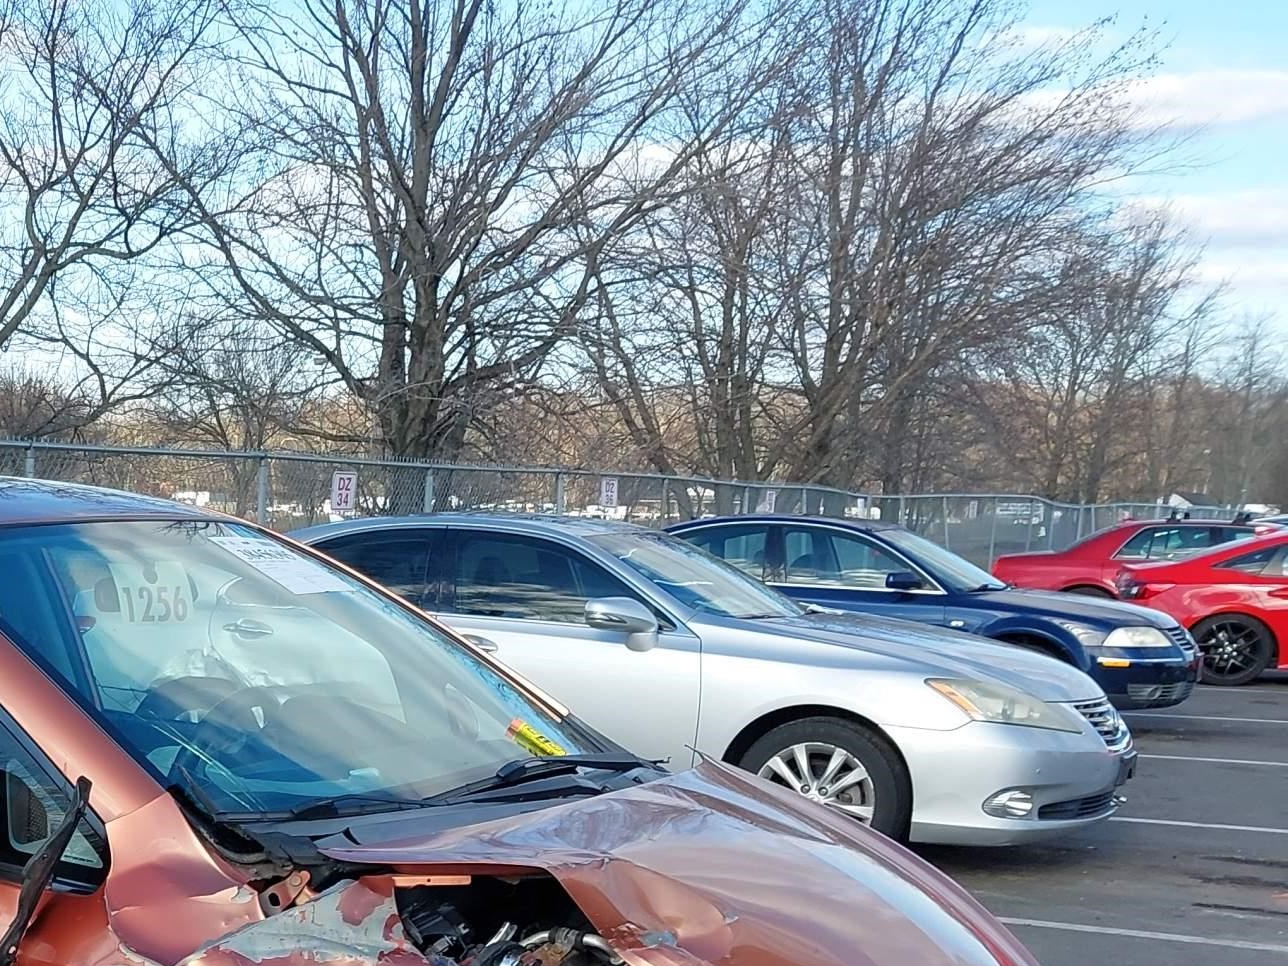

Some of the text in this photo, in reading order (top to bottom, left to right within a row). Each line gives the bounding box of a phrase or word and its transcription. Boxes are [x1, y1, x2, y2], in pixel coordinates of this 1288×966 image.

[338, 477, 352, 491] DZ
[336, 492, 349, 507] 34
[121, 586, 187, 622] 1256
